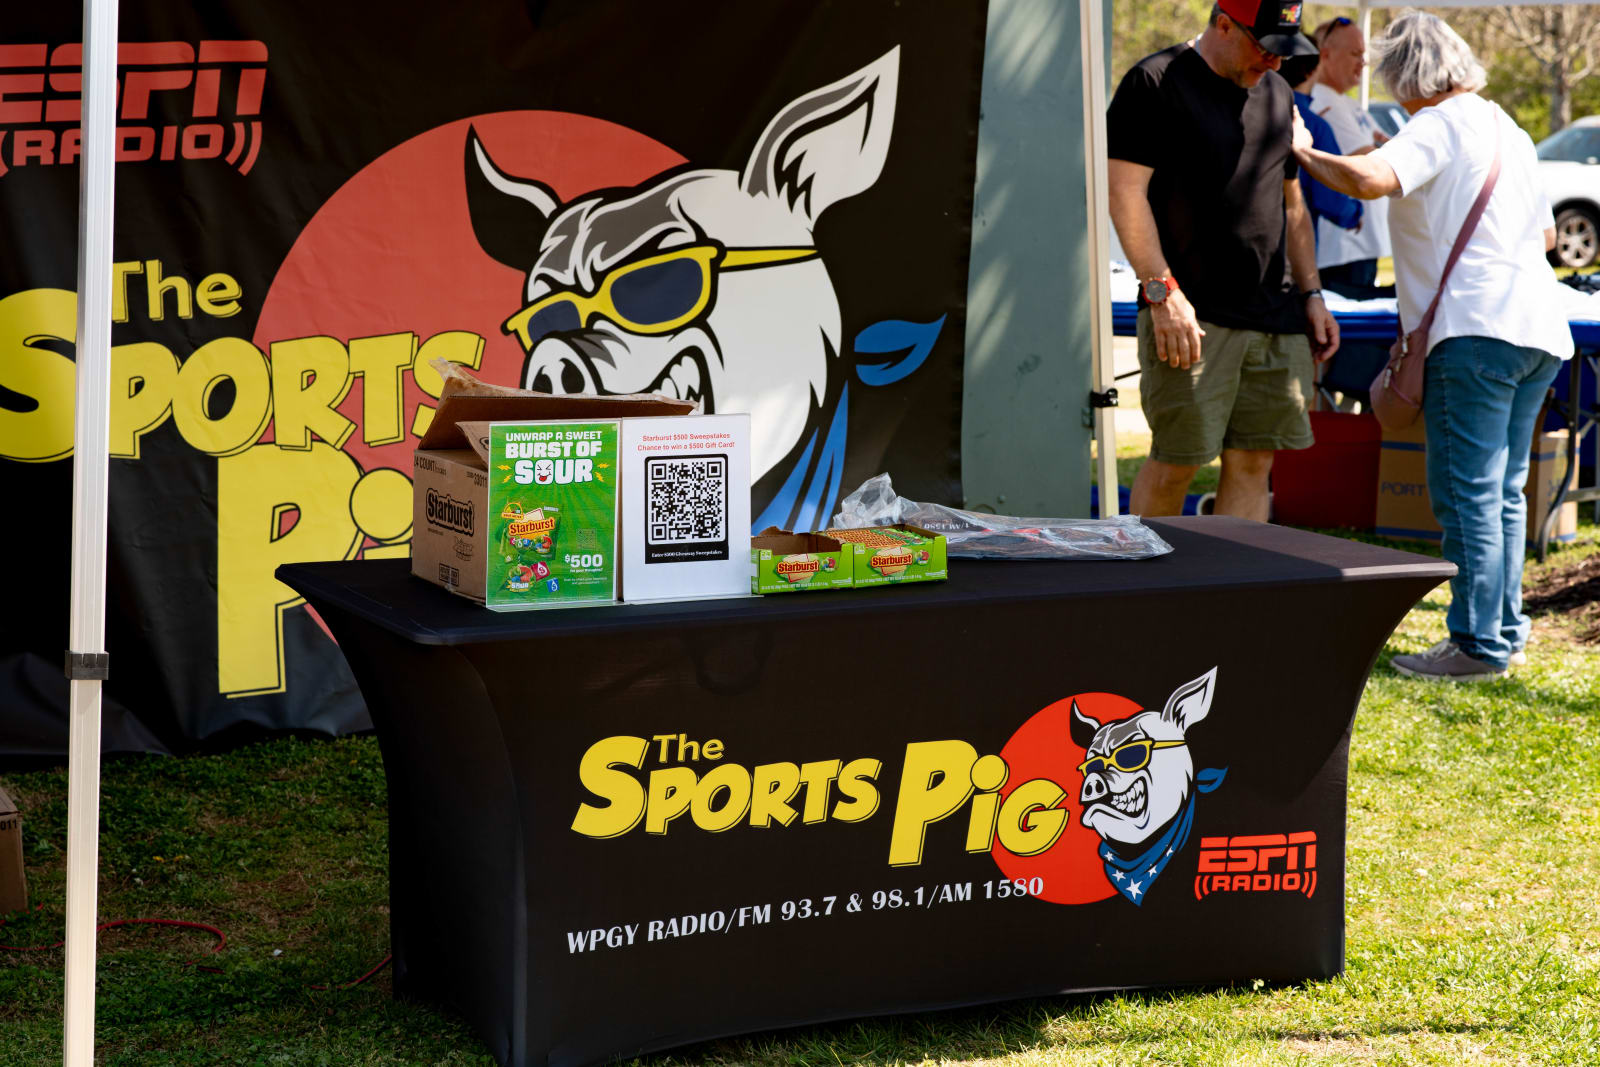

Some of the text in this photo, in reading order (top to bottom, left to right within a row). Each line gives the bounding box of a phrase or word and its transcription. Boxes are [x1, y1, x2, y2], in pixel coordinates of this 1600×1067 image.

[111, 258, 243, 324] The
[505, 431, 602, 441] UNWRAP A SWEET
[642, 434, 672, 442] Starburst
[689, 432, 731, 440] Sweepstakes
[505, 441, 602, 458] BURST OF
[637, 444, 662, 452] Chance
[705, 441, 717, 449] Gift
[514, 458, 593, 485] SOUR
[1381, 482, 1426, 497] PORT
[427, 490, 473, 533] Starburst
[509, 518, 554, 536] Starburst
[564, 554, 603, 568] $500
[777, 561, 818, 573] Starburst
[872, 554, 912, 567] Starburst
[652, 733, 725, 764] The
[570, 734, 883, 840] SPORTS
[1198, 831, 1317, 873] ESPN
[1211, 872, 1301, 892] RADIO
[567, 876, 1045, 954] WPGY RADIO/FM 93.7 & 98.1/AM 1580
